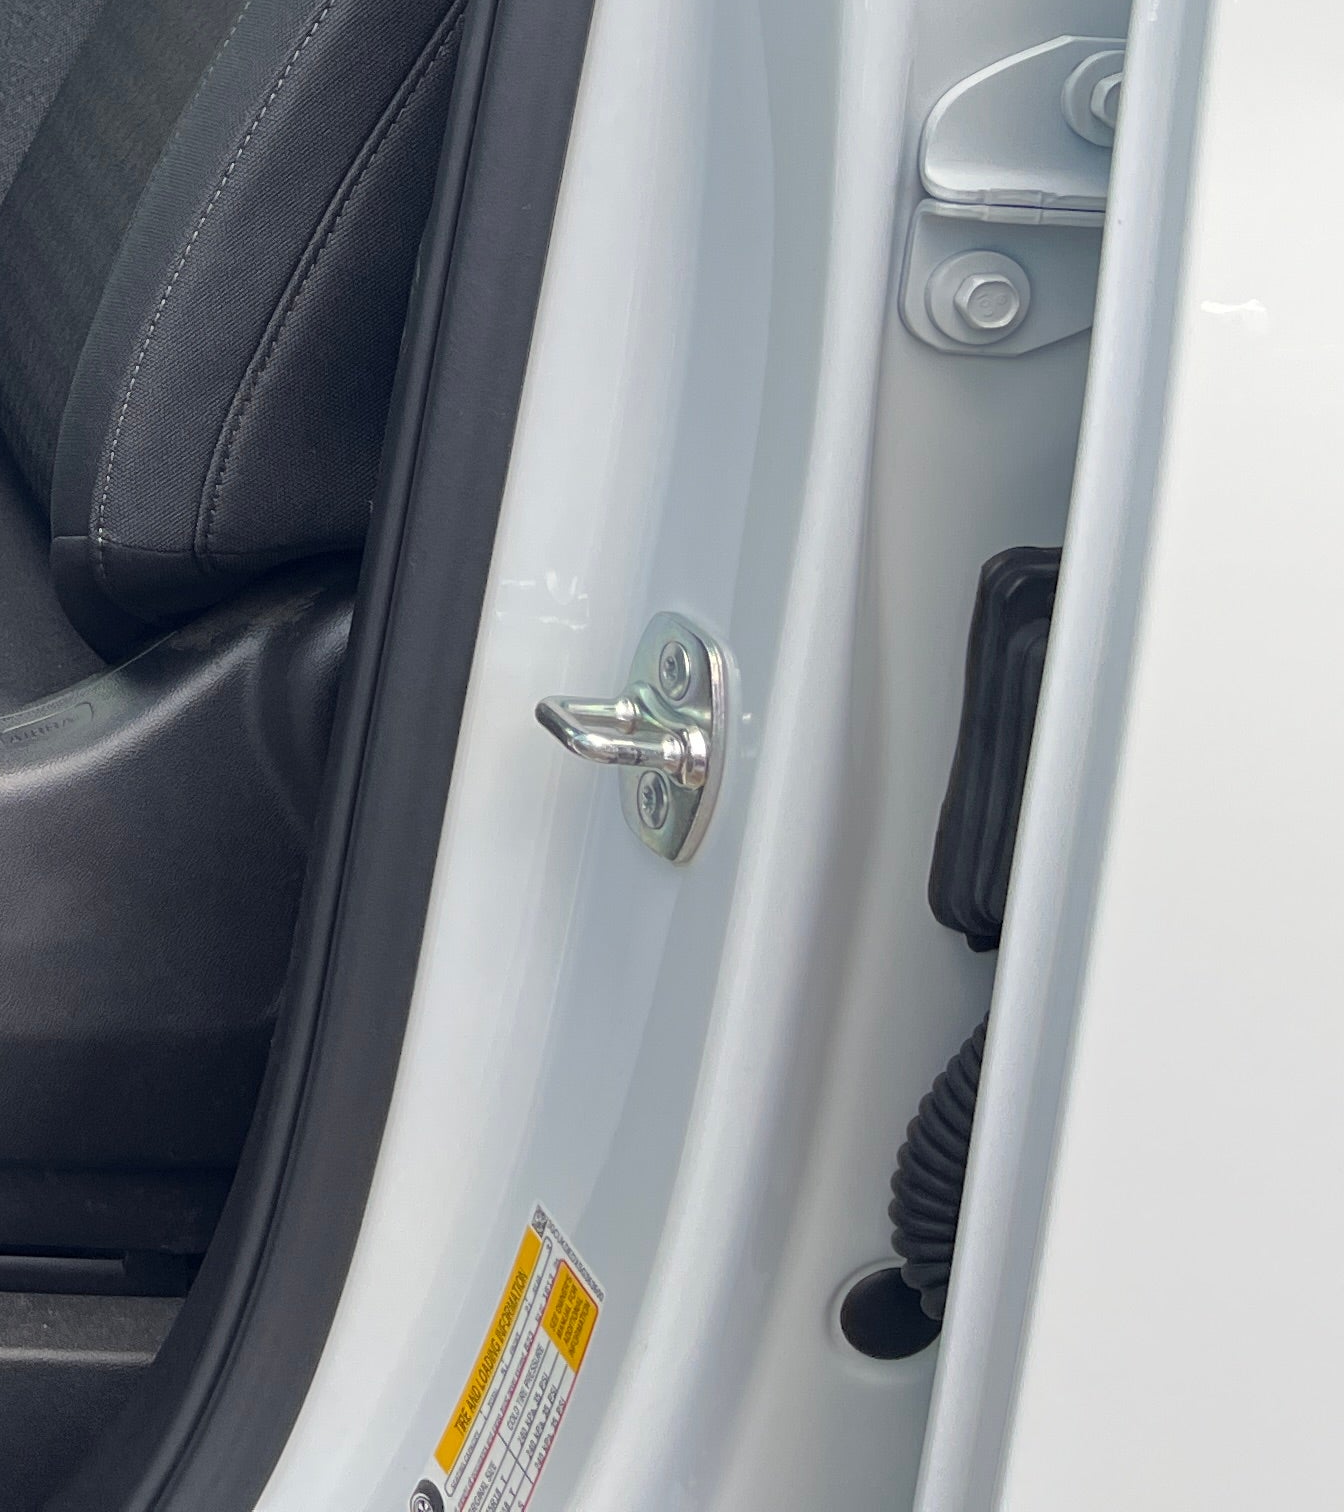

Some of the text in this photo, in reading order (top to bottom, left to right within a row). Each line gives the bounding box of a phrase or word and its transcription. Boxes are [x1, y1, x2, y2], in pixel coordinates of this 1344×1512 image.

[453, 1405, 471, 1439] TIRE
[465, 1382, 481, 1414] AND
[474, 1335, 501, 1392] LOADING
[493, 1266, 529, 1344] INFORMATION
